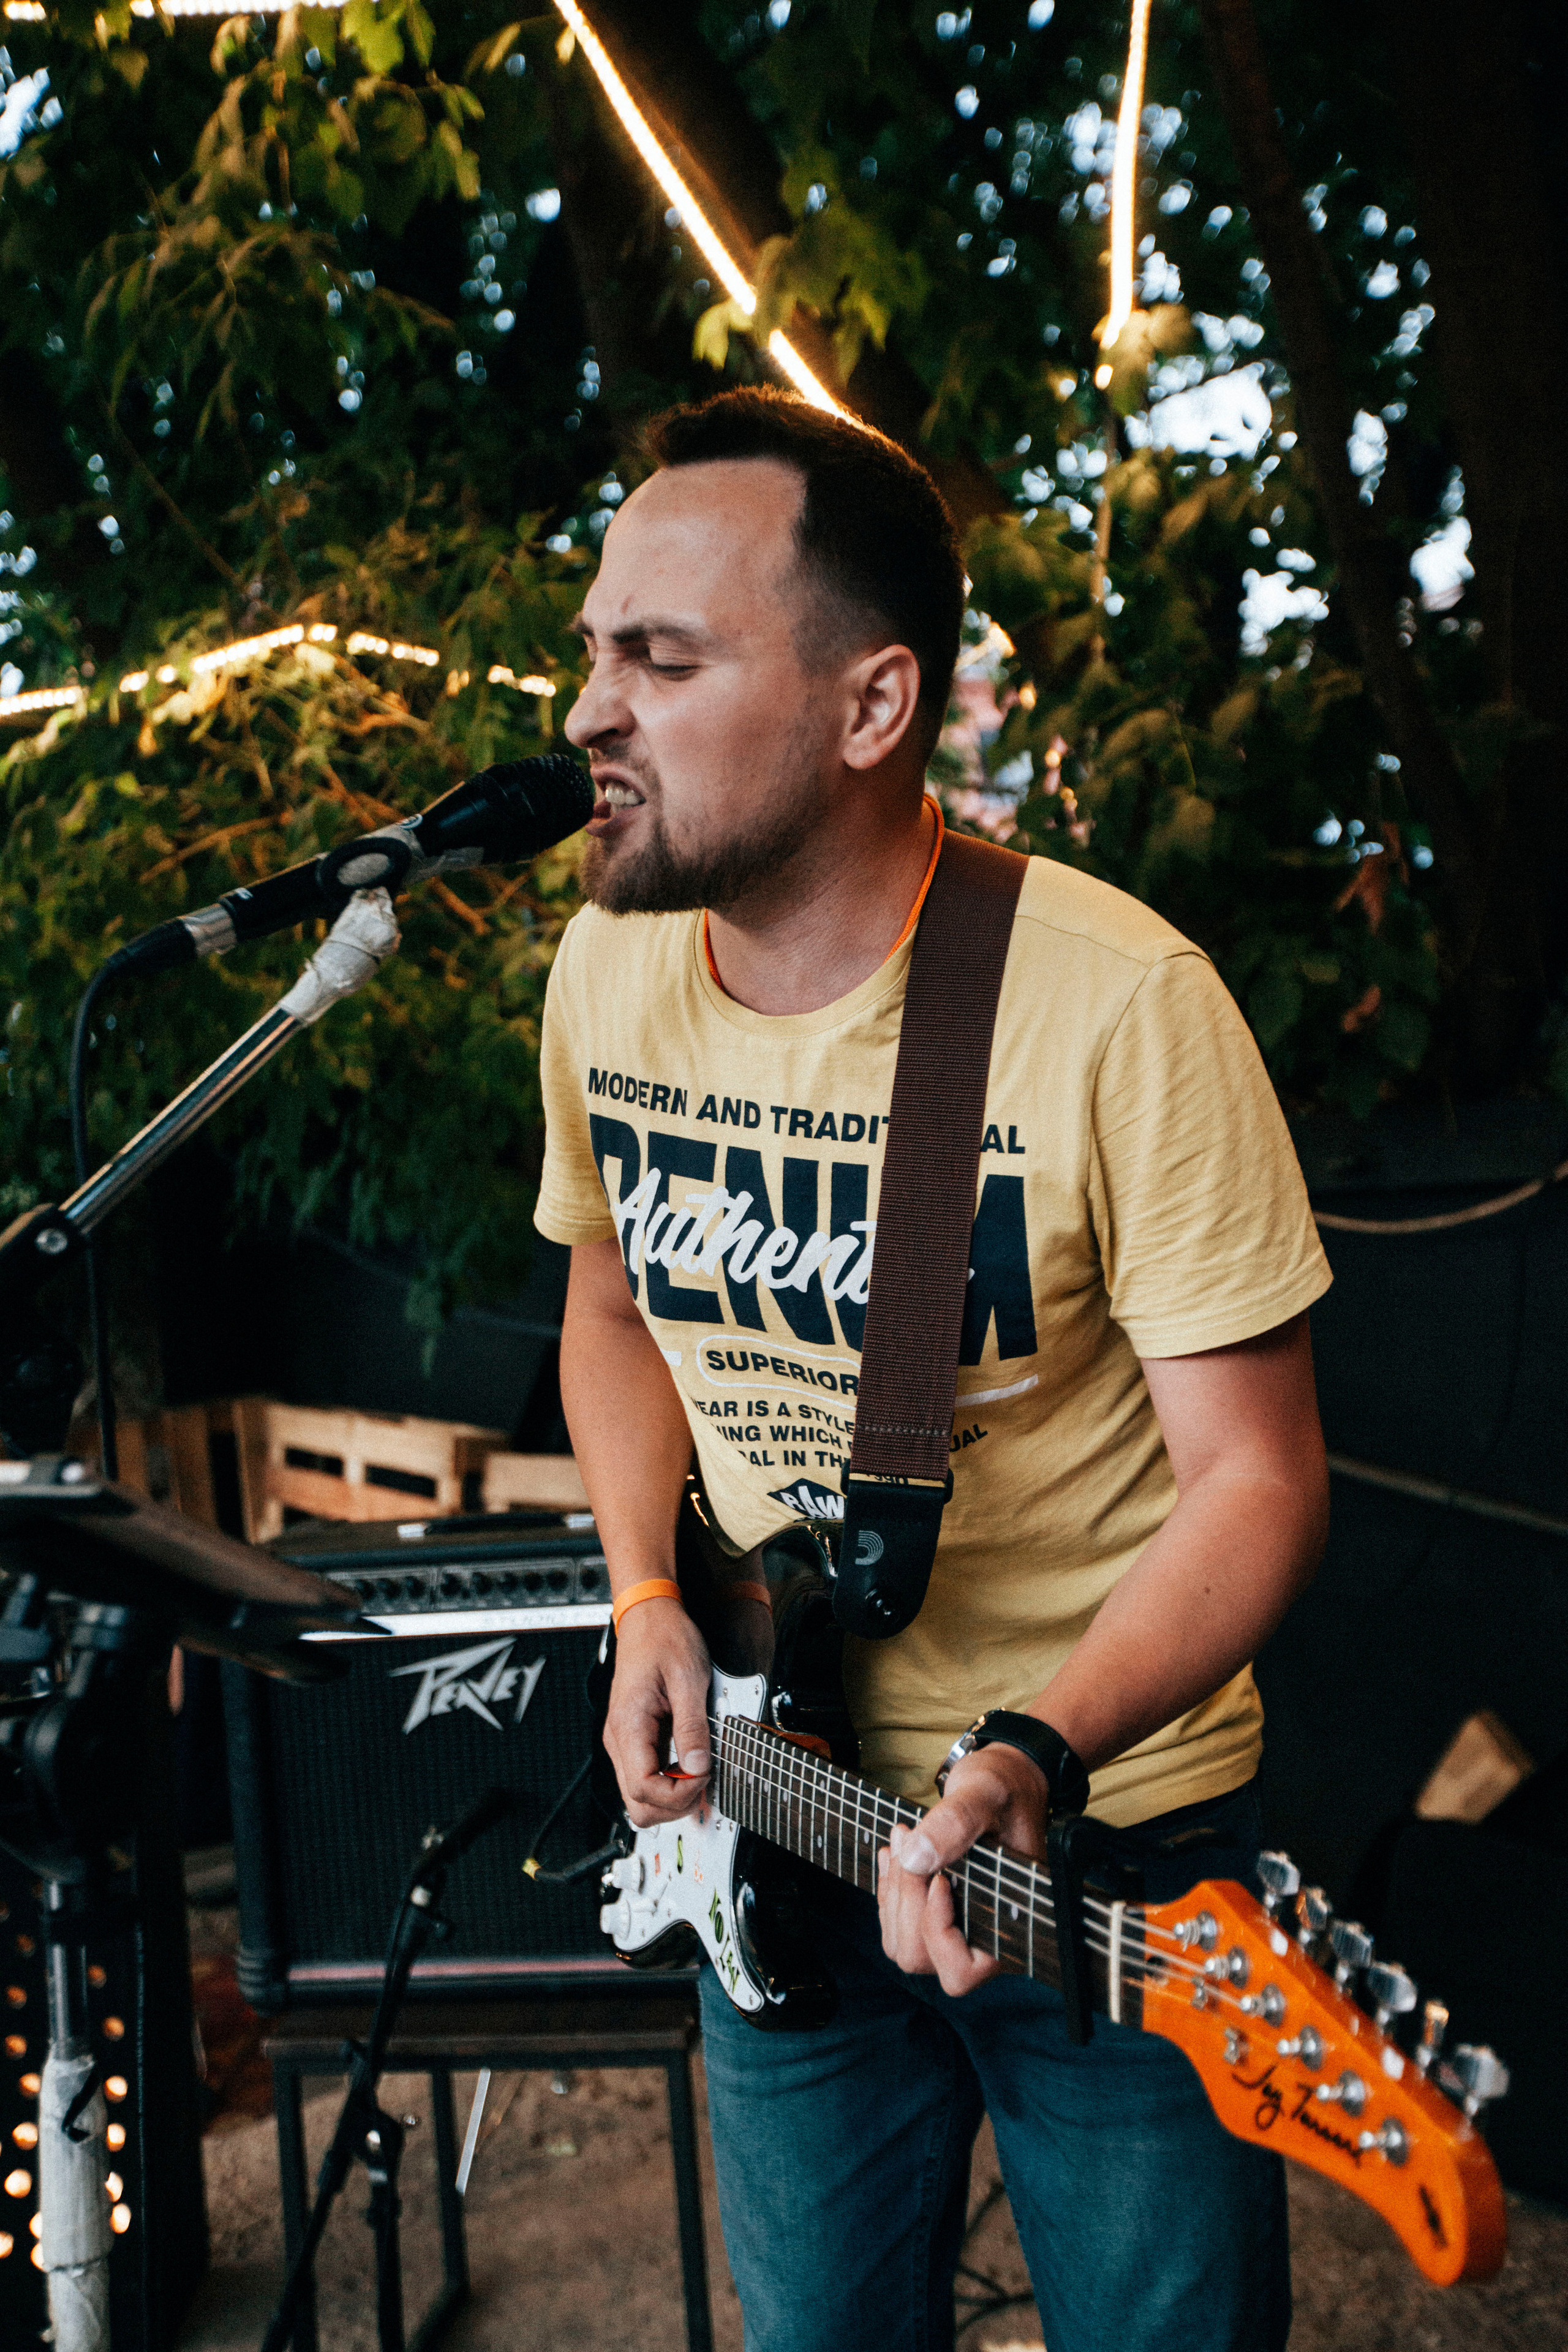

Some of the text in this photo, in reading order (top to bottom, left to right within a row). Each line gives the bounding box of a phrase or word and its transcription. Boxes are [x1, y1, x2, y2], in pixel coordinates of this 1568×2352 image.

[588, 1067, 1026, 1154] MODERN AND TRADIAL
[613, 1167, 975, 1305] Authent
[706, 1349, 859, 1396] SUPERIOR
[691, 1398, 738, 1417] EAR
[747, 1400, 769, 1417] IS
[777, 1401, 792, 1417] A
[798, 1404, 855, 1436] STYLE
[716, 1425, 843, 1449] ING WHICH
[737, 1450, 850, 1468] AL IN TH
[780, 1485, 845, 1520] RAW
